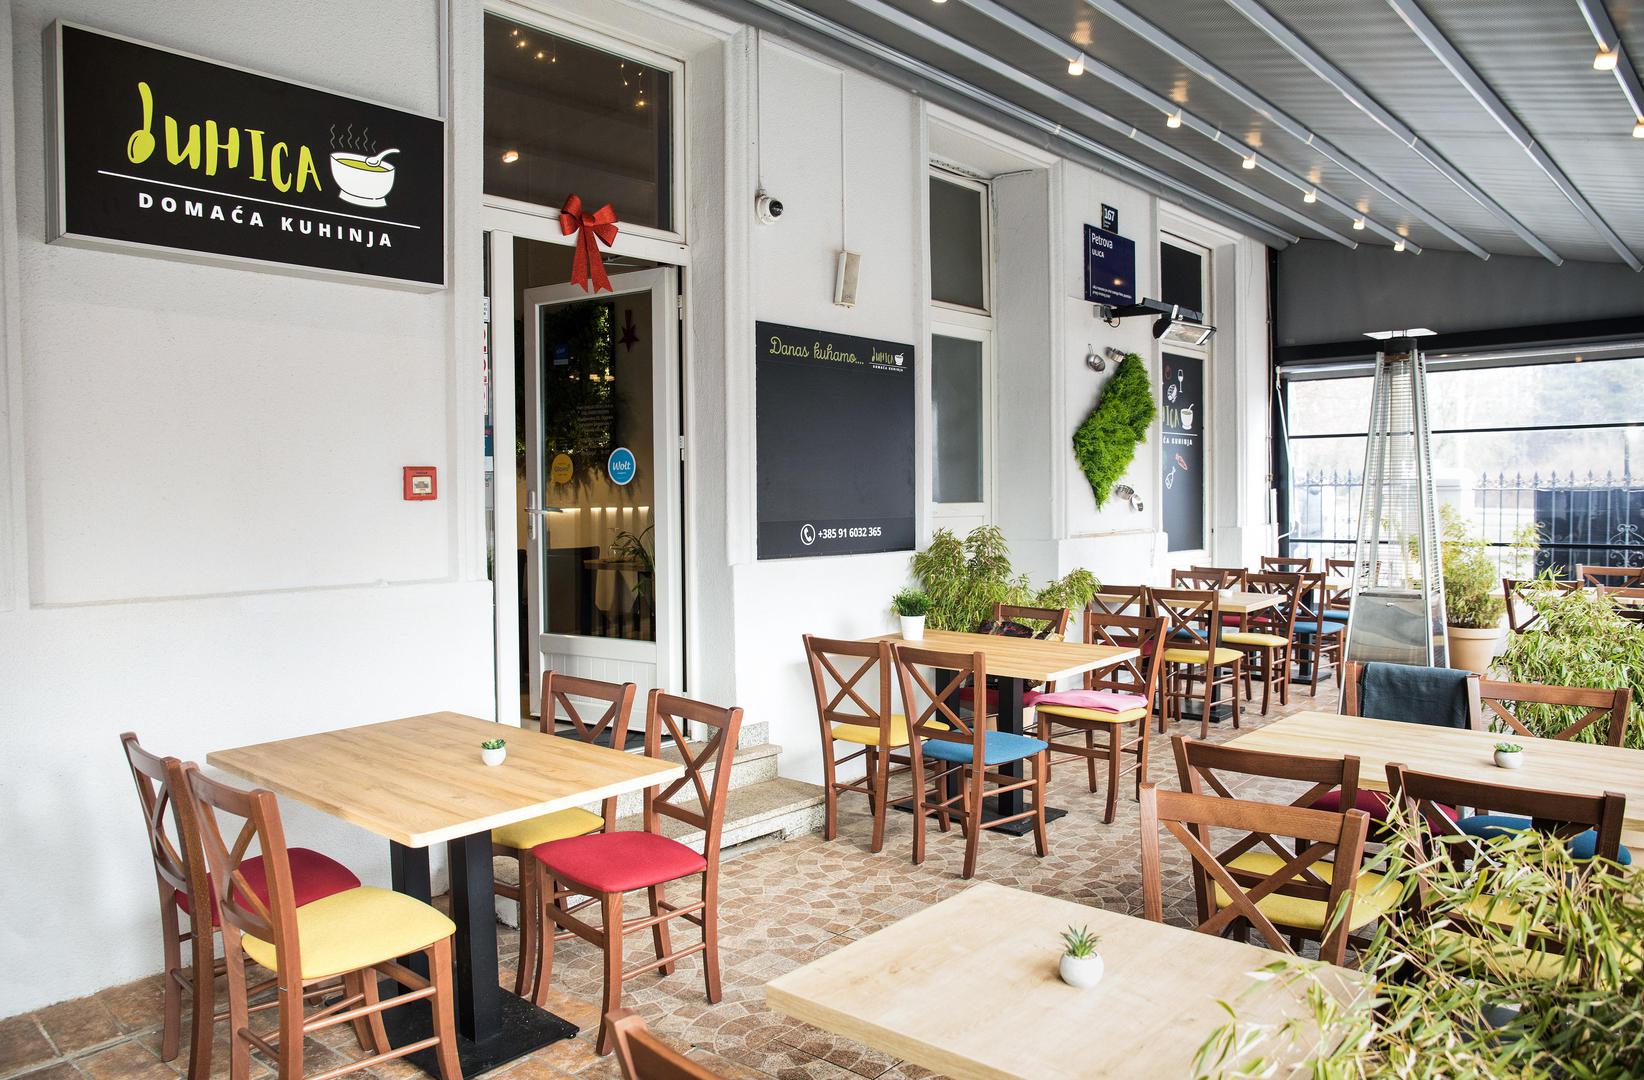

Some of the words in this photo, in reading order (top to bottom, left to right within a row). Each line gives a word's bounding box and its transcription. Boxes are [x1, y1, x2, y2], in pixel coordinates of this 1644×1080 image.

[127, 81, 322, 193] JUHICA
[138, 192, 264, 228] DOMAĆA
[281, 216, 392, 248] KUHINJA
[1104, 208, 1115, 221] 167
[1091, 232, 1113, 249] Petrova
[1091, 248, 1105, 258] ULICA
[769, 336, 809, 357] Danas
[612, 460, 631, 471] Wolt
[818, 528, 837, 539] +385
[838, 528, 848, 538] 91
[849, 527, 867, 538] 6032
[868, 526, 882, 537] 365
